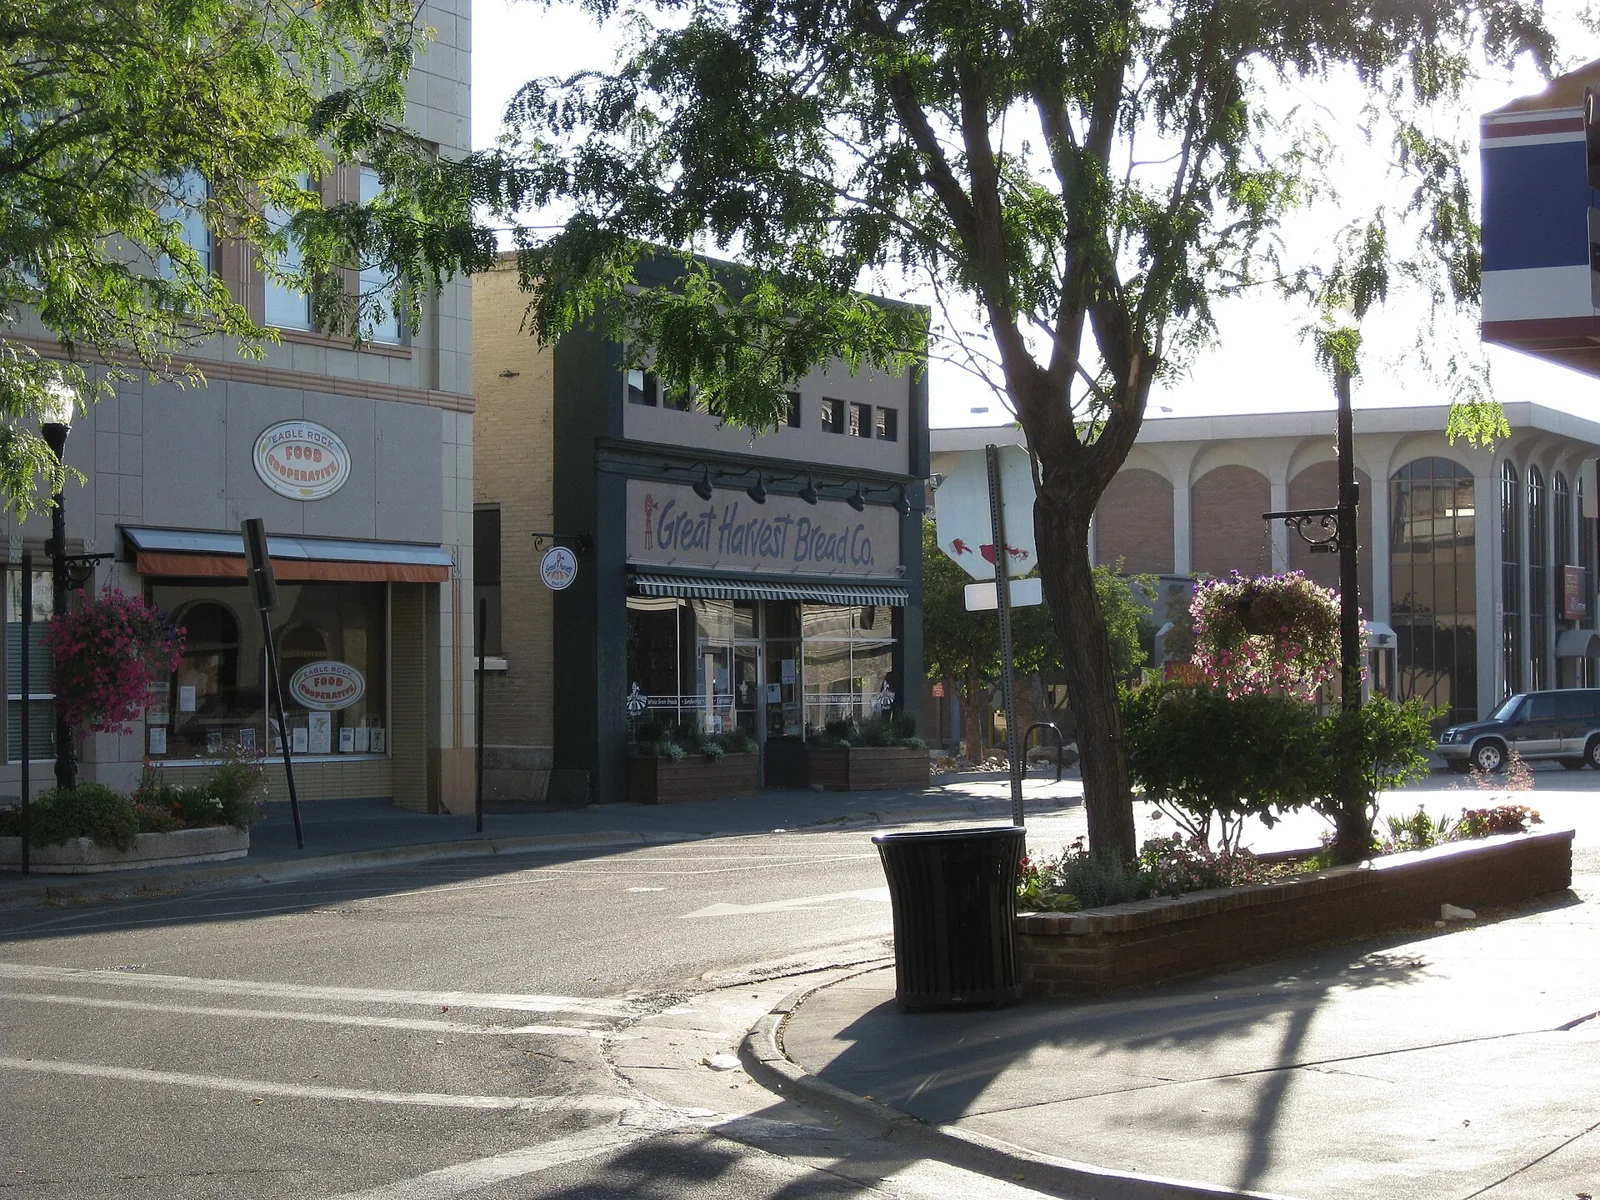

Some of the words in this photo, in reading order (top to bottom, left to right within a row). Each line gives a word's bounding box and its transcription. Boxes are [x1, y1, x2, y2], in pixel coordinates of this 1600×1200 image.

[272, 429, 304, 444] EAGLE
[307, 431, 334, 449] ROCK
[285, 445, 323, 463] FOOD
[269, 454, 337, 482] COOPERATIVE
[656, 498, 717, 552] Great
[718, 501, 794, 560] Harvest
[794, 516, 849, 564] Bread
[850, 523, 875, 566] Co.
[303, 666, 329, 678] EAGLE
[331, 666, 353, 677] ROCK
[313, 676, 344, 687] FOOD
[300, 684, 356, 700] COOPERATIVE
